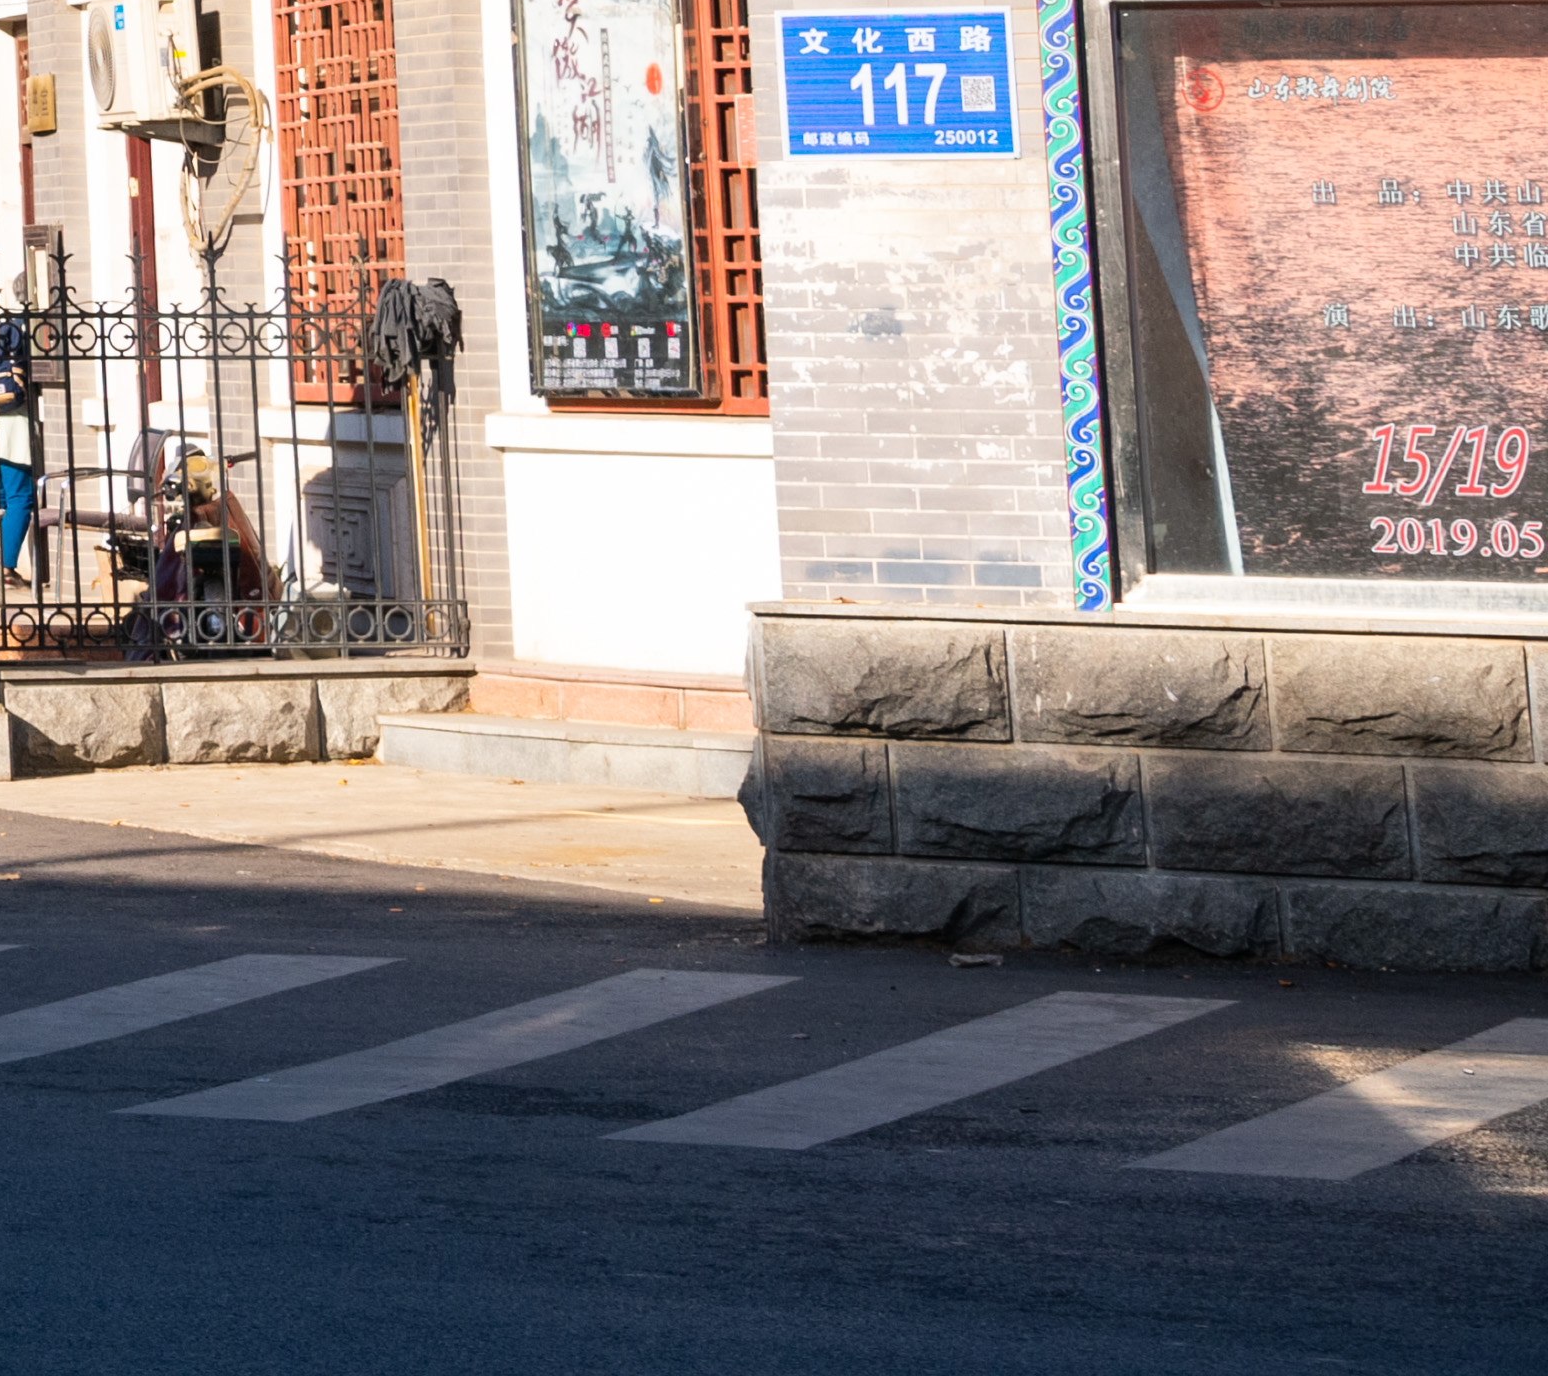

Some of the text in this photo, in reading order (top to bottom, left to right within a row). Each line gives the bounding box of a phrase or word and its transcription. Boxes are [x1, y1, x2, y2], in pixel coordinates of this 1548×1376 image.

[798, 25, 993, 55] 文化西路
[849, 62, 948, 127] 117
[1247, 74, 1398, 106] 山东歌舞剧院
[802, 131, 870, 147] 邮政编码
[934, 129, 999, 146] 250012
[1446, 178, 1543, 205] 中共山
[1452, 210, 1547, 237] 山东省
[1454, 242, 1548, 268] 中共临
[1362, 423, 1530, 506] 15/19
[1370, 515, 1545, 558] 2019.05
